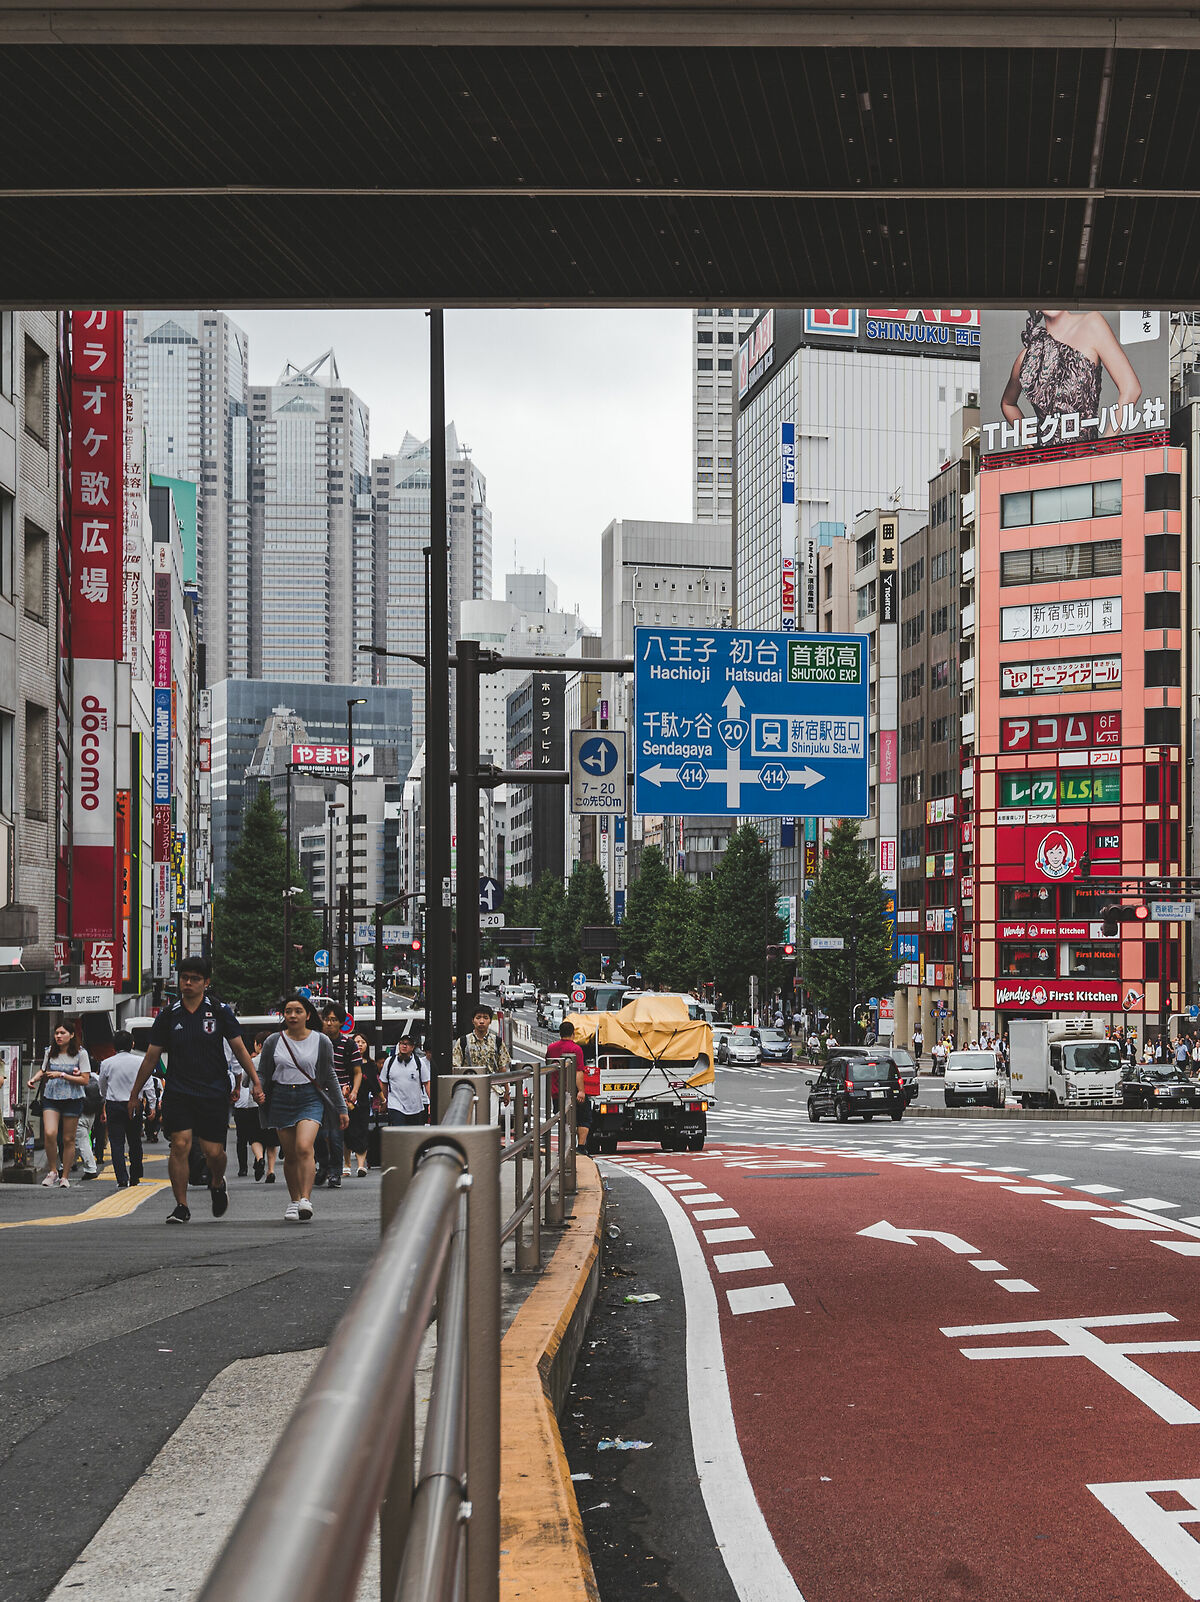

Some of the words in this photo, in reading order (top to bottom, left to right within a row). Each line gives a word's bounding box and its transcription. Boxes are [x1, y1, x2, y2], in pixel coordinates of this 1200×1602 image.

[748, 311, 772, 370] LABI
[866, 321, 949, 345] SHINJUKU
[956, 329, 980, 346] 西口
[982, 397, 1165, 450] THEグローバル社
[80, 311, 109, 603] カラオケ歌広場
[786, 456, 794, 482] LABI
[783, 571, 795, 612] LABI
[1033, 603, 1090, 622] 新宿駅前
[1102, 601, 1113, 629] 歯科
[1012, 620, 1092, 638] デンタルクリニック
[644, 636, 717, 663] 八王子
[729, 638, 779, 665] 初台
[792, 645, 857, 668] 首都高
[650, 665, 710, 684] Hachioji
[725, 667, 782, 683] Hatsudai
[791, 668, 836, 681] SHUTOKO
[839, 671, 858, 681] EXP
[1033, 667, 1120, 687] エーアイアール
[156, 706, 169, 740] JAPAN
[541, 683, 552, 764] ホウライビル
[724, 725, 743, 741] 20
[791, 720, 860, 741] 新宿駅西口
[1008, 717, 1088, 747] アコム
[1099, 716, 1116, 728] 6F
[81, 695, 107, 811] docomo
[156, 743, 169, 771] TOTAL
[297, 746, 350, 764] やまや
[642, 740, 712, 758] Sendagaya
[791, 742, 830, 755] Shinjuku
[1093, 752, 1118, 763] アコム
[156, 772, 169, 799] CLUB
[683, 768, 703, 783] 414
[763, 769, 784, 784] 414
[575, 795, 622, 807] この先50m
[806, 848, 815, 874] トレカ
[1040, 927, 1056, 935] First
[1059, 927, 1085, 935] Kitchen
[91, 941, 114, 979] 広場
[996, 986, 1031, 1005] Wendy's
[1049, 990, 1074, 1001] First
[1076, 990, 1118, 1002] Kitchen
